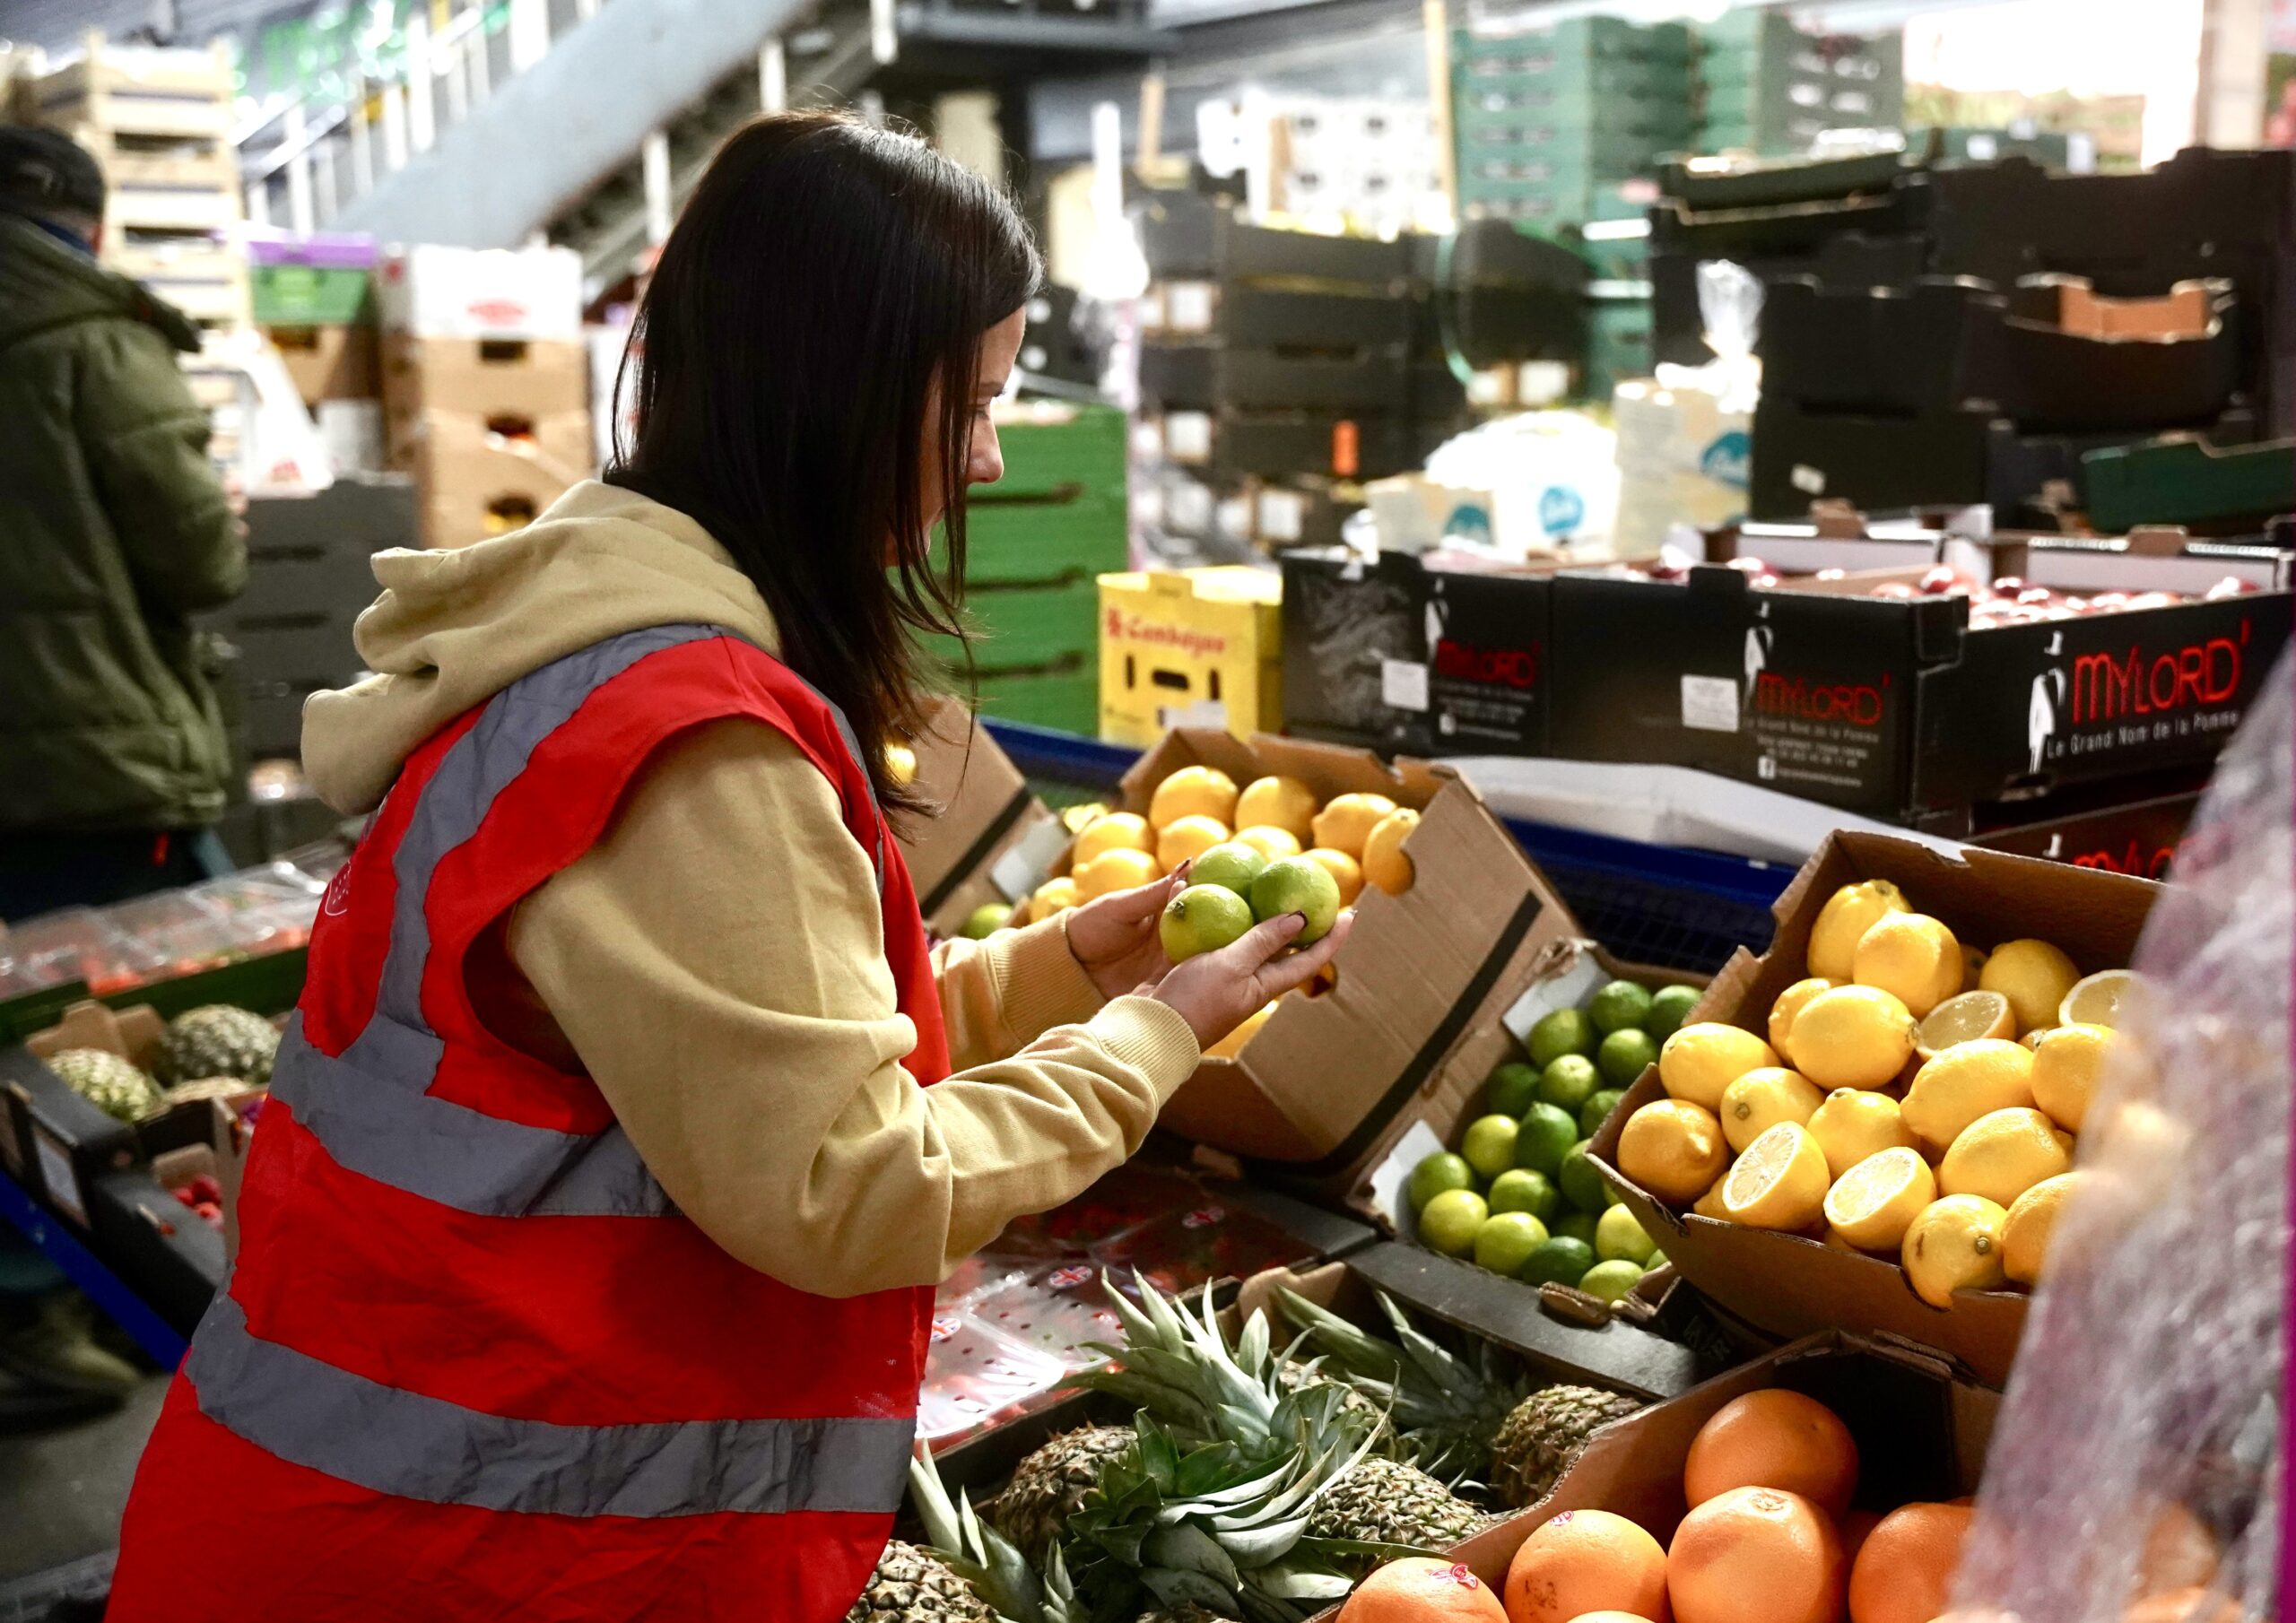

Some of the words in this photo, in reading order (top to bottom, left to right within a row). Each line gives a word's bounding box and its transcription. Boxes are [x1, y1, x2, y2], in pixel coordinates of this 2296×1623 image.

[2047, 739, 2065, 759] Le
[2070, 730, 2114, 755] Grand
[2118, 725, 2148, 745] Nom
[2153, 720, 2172, 741] de
[2175, 717, 2190, 736] la
[2194, 710, 2239, 732] Pomme
